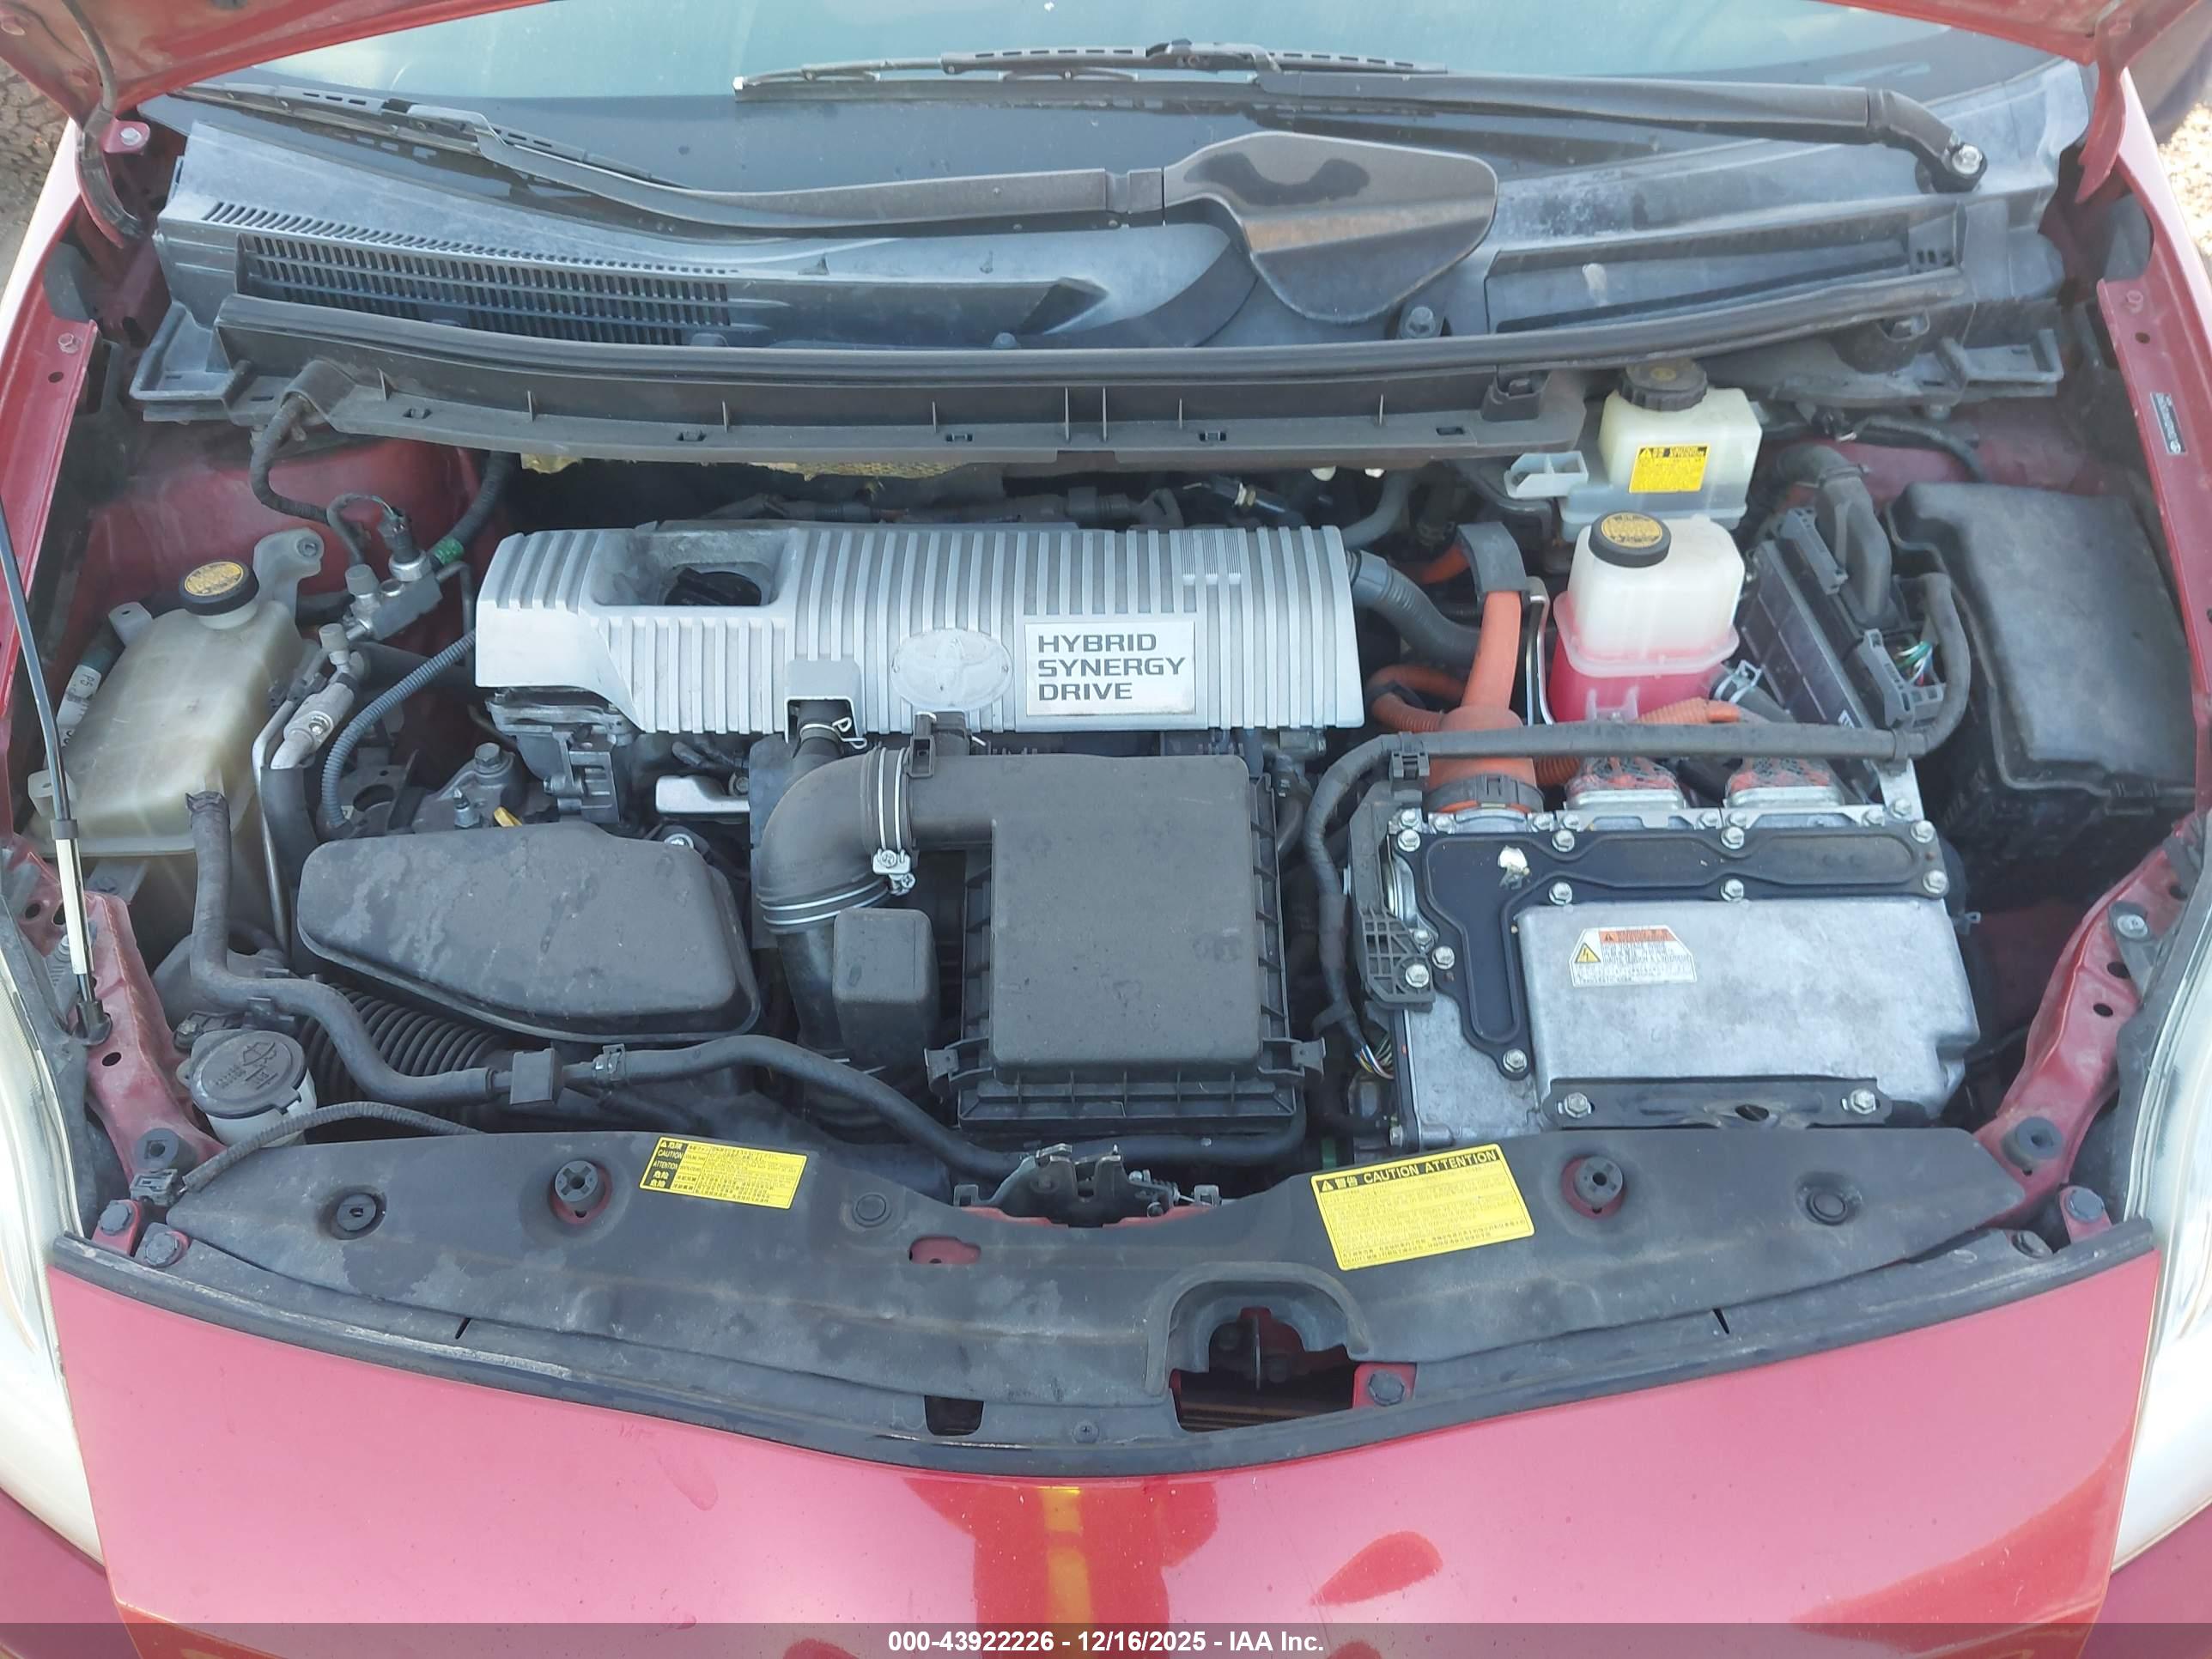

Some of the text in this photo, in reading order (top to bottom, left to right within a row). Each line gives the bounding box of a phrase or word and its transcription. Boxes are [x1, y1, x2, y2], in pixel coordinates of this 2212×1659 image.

[1038, 634, 1157, 653] HYBRID
[1038, 657, 1186, 678] SYNERGY
[1038, 683, 1133, 701] DRIVE
[657, 1149, 684, 1159] CAUTION
[653, 1160, 678, 1170] ATTENTION
[1364, 1164, 1419, 1184] CAUTION
[1425, 1149, 1497, 1175] ATTENTION
